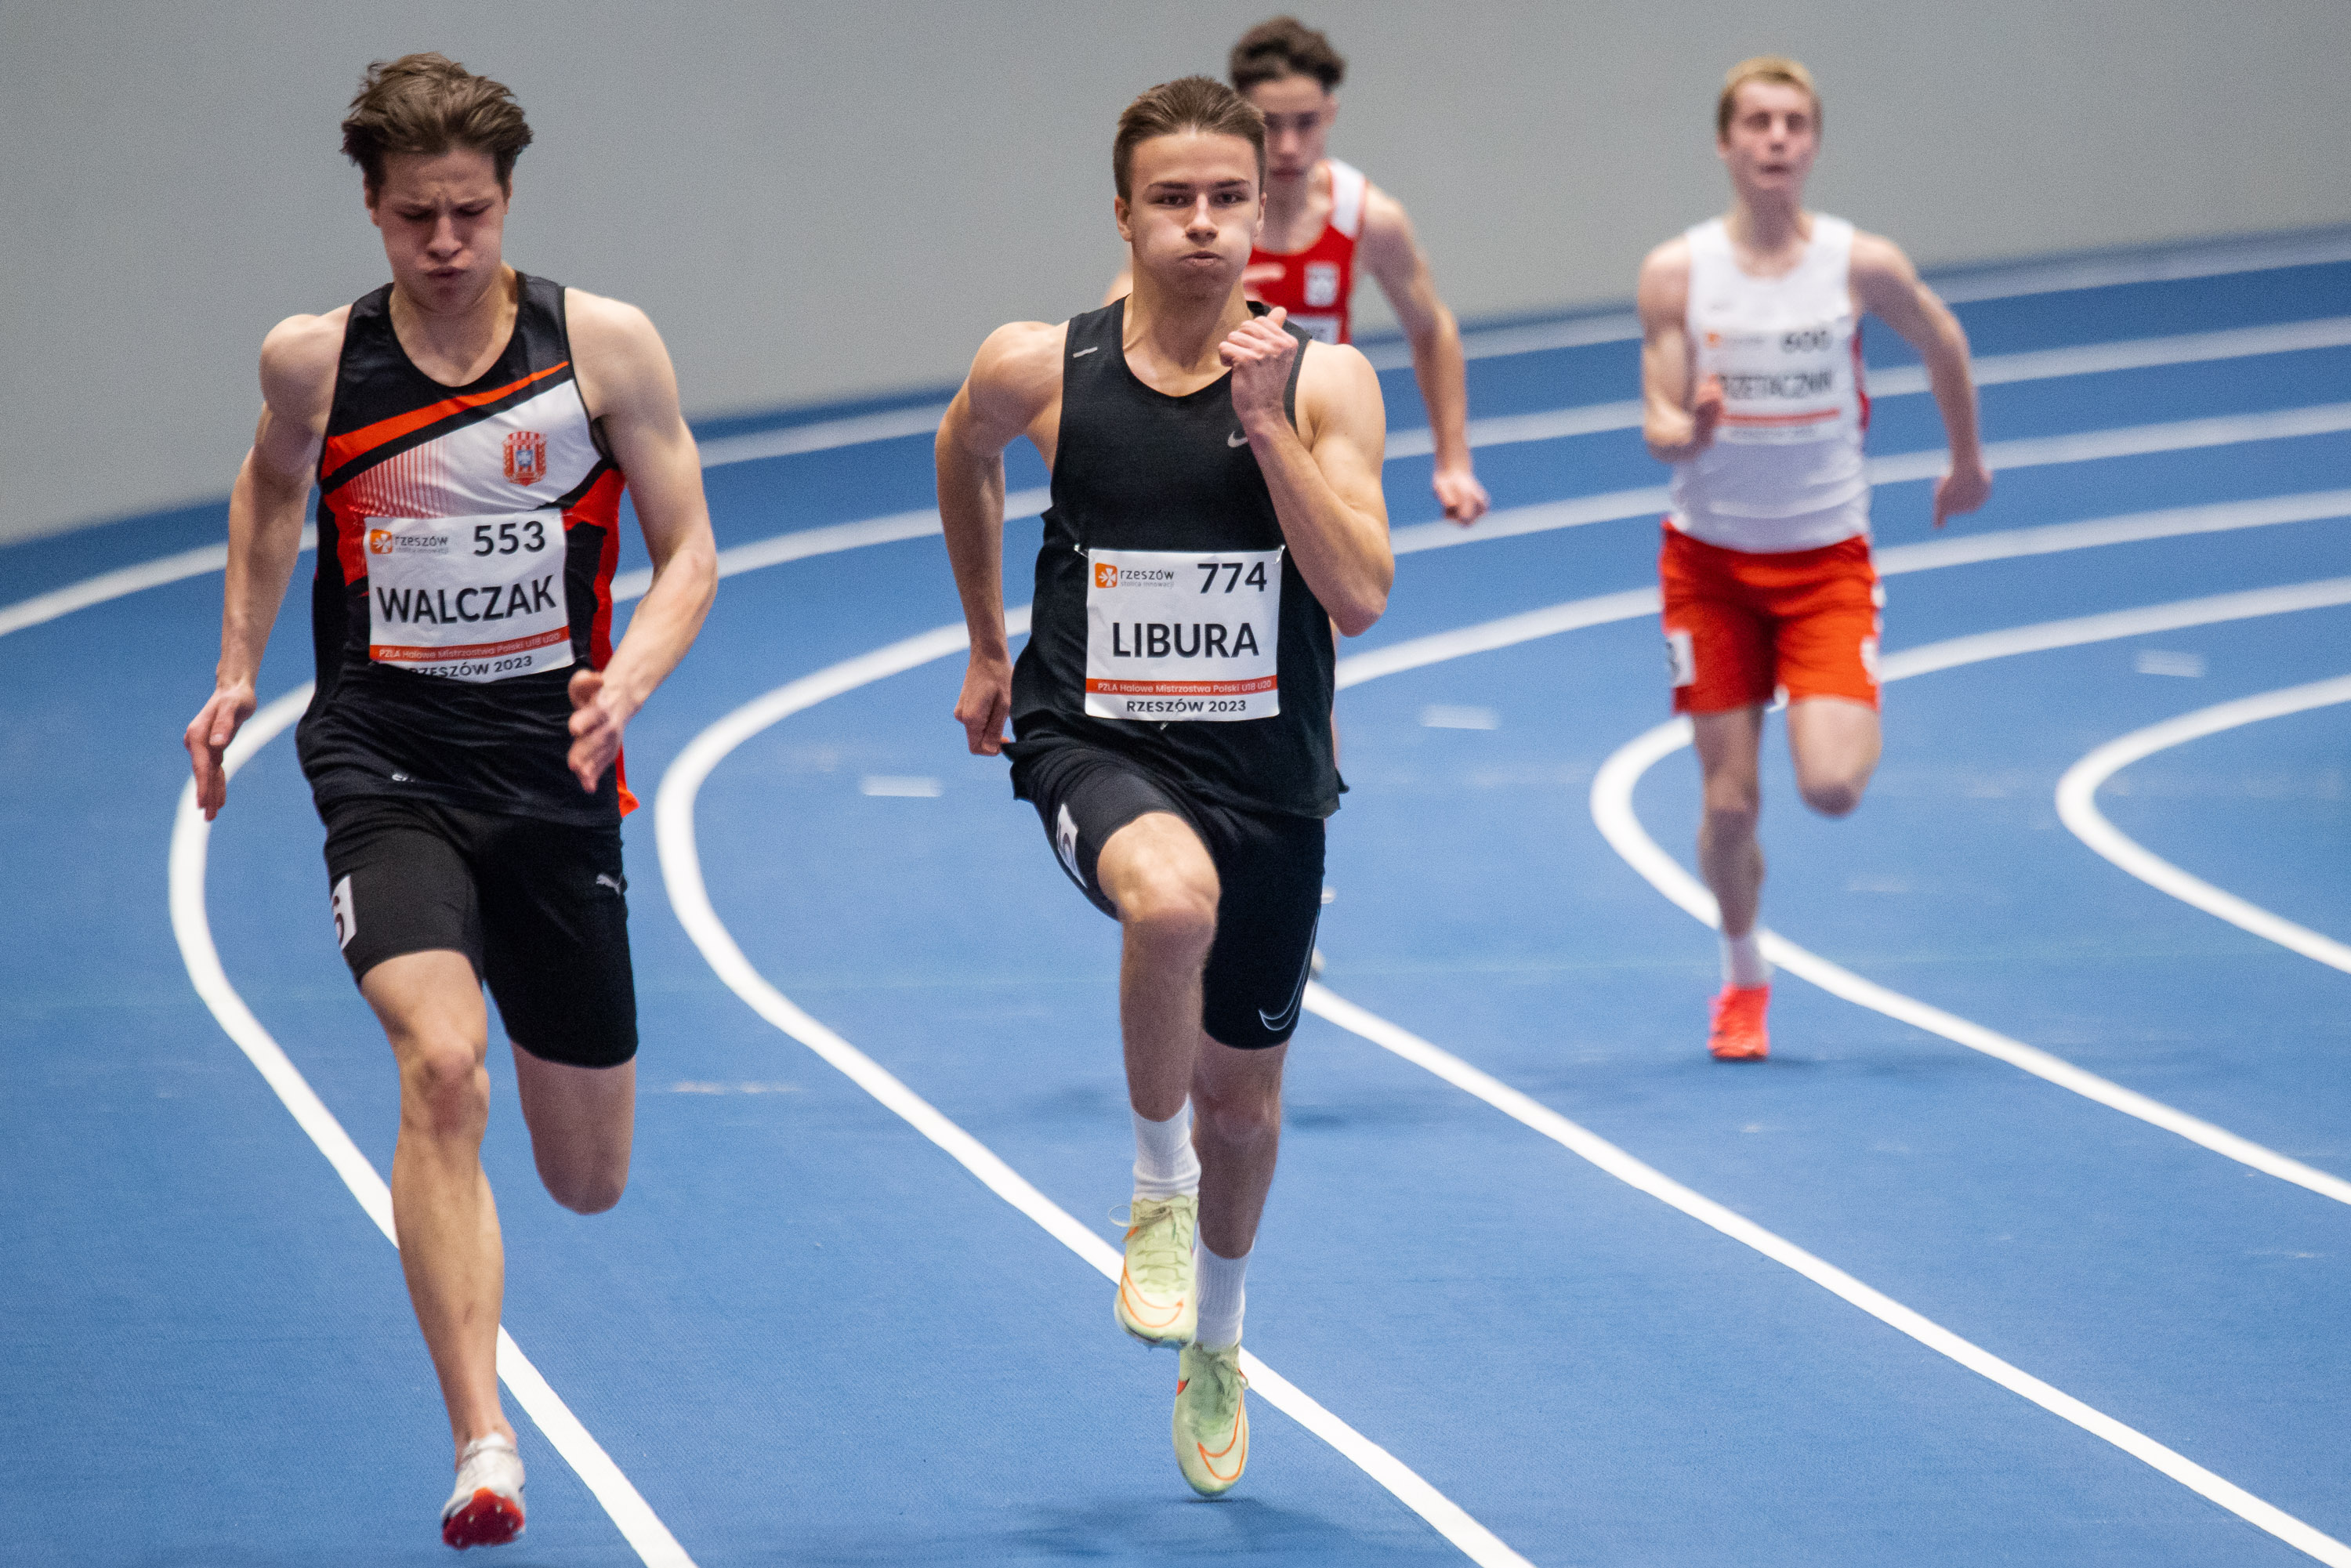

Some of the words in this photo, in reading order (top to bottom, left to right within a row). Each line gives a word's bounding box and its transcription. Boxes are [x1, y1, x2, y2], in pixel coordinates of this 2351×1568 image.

[394, 535, 448, 547] rzeszów
[473, 521, 545, 557] 553
[1120, 569, 1174, 580] rzeszów
[1197, 561, 1267, 594] 774
[376, 575, 556, 624] WALCZAK
[1113, 622, 1259, 658] LIBURA
[379, 649, 400, 658] PZLA
[403, 650, 436, 660] Halowe
[437, 647, 495, 659] Mistrzostwa
[497, 642, 523, 655] Polski
[494, 656, 533, 673] 2023
[1098, 683, 1118, 692] PZLA
[1156, 685, 1212, 693] Mistrzostwa
[1213, 683, 1240, 693] Polski
[1242, 683, 1256, 692] U18
[1258, 680, 1272, 690] U20
[1127, 698, 1204, 713] RZESZÓW
[1208, 700, 1247, 712] 2023
